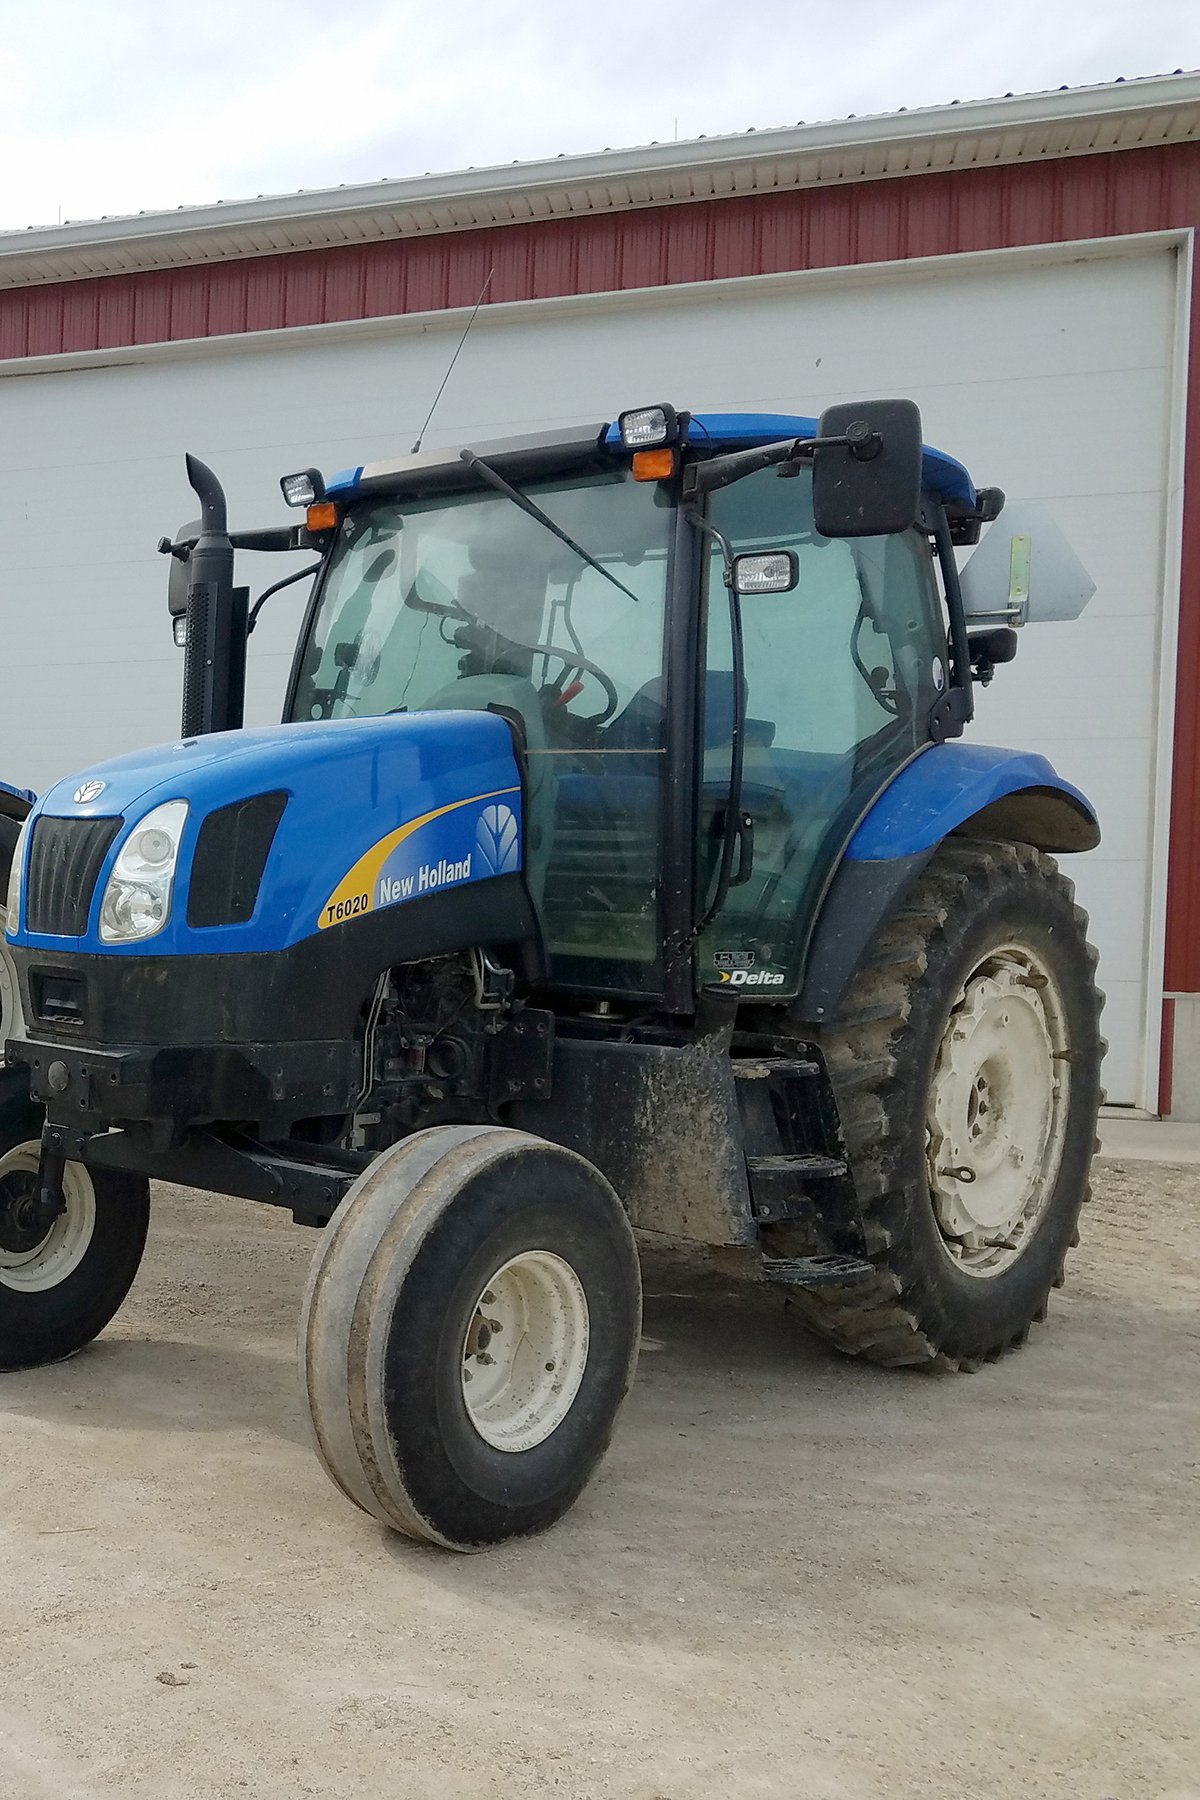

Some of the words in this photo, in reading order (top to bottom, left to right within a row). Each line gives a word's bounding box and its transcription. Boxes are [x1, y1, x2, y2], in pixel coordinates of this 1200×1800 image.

[379, 876, 414, 904] New
[418, 853, 472, 892] Holland
[327, 893, 369, 923] T6020
[729, 970, 785, 985] Delta
